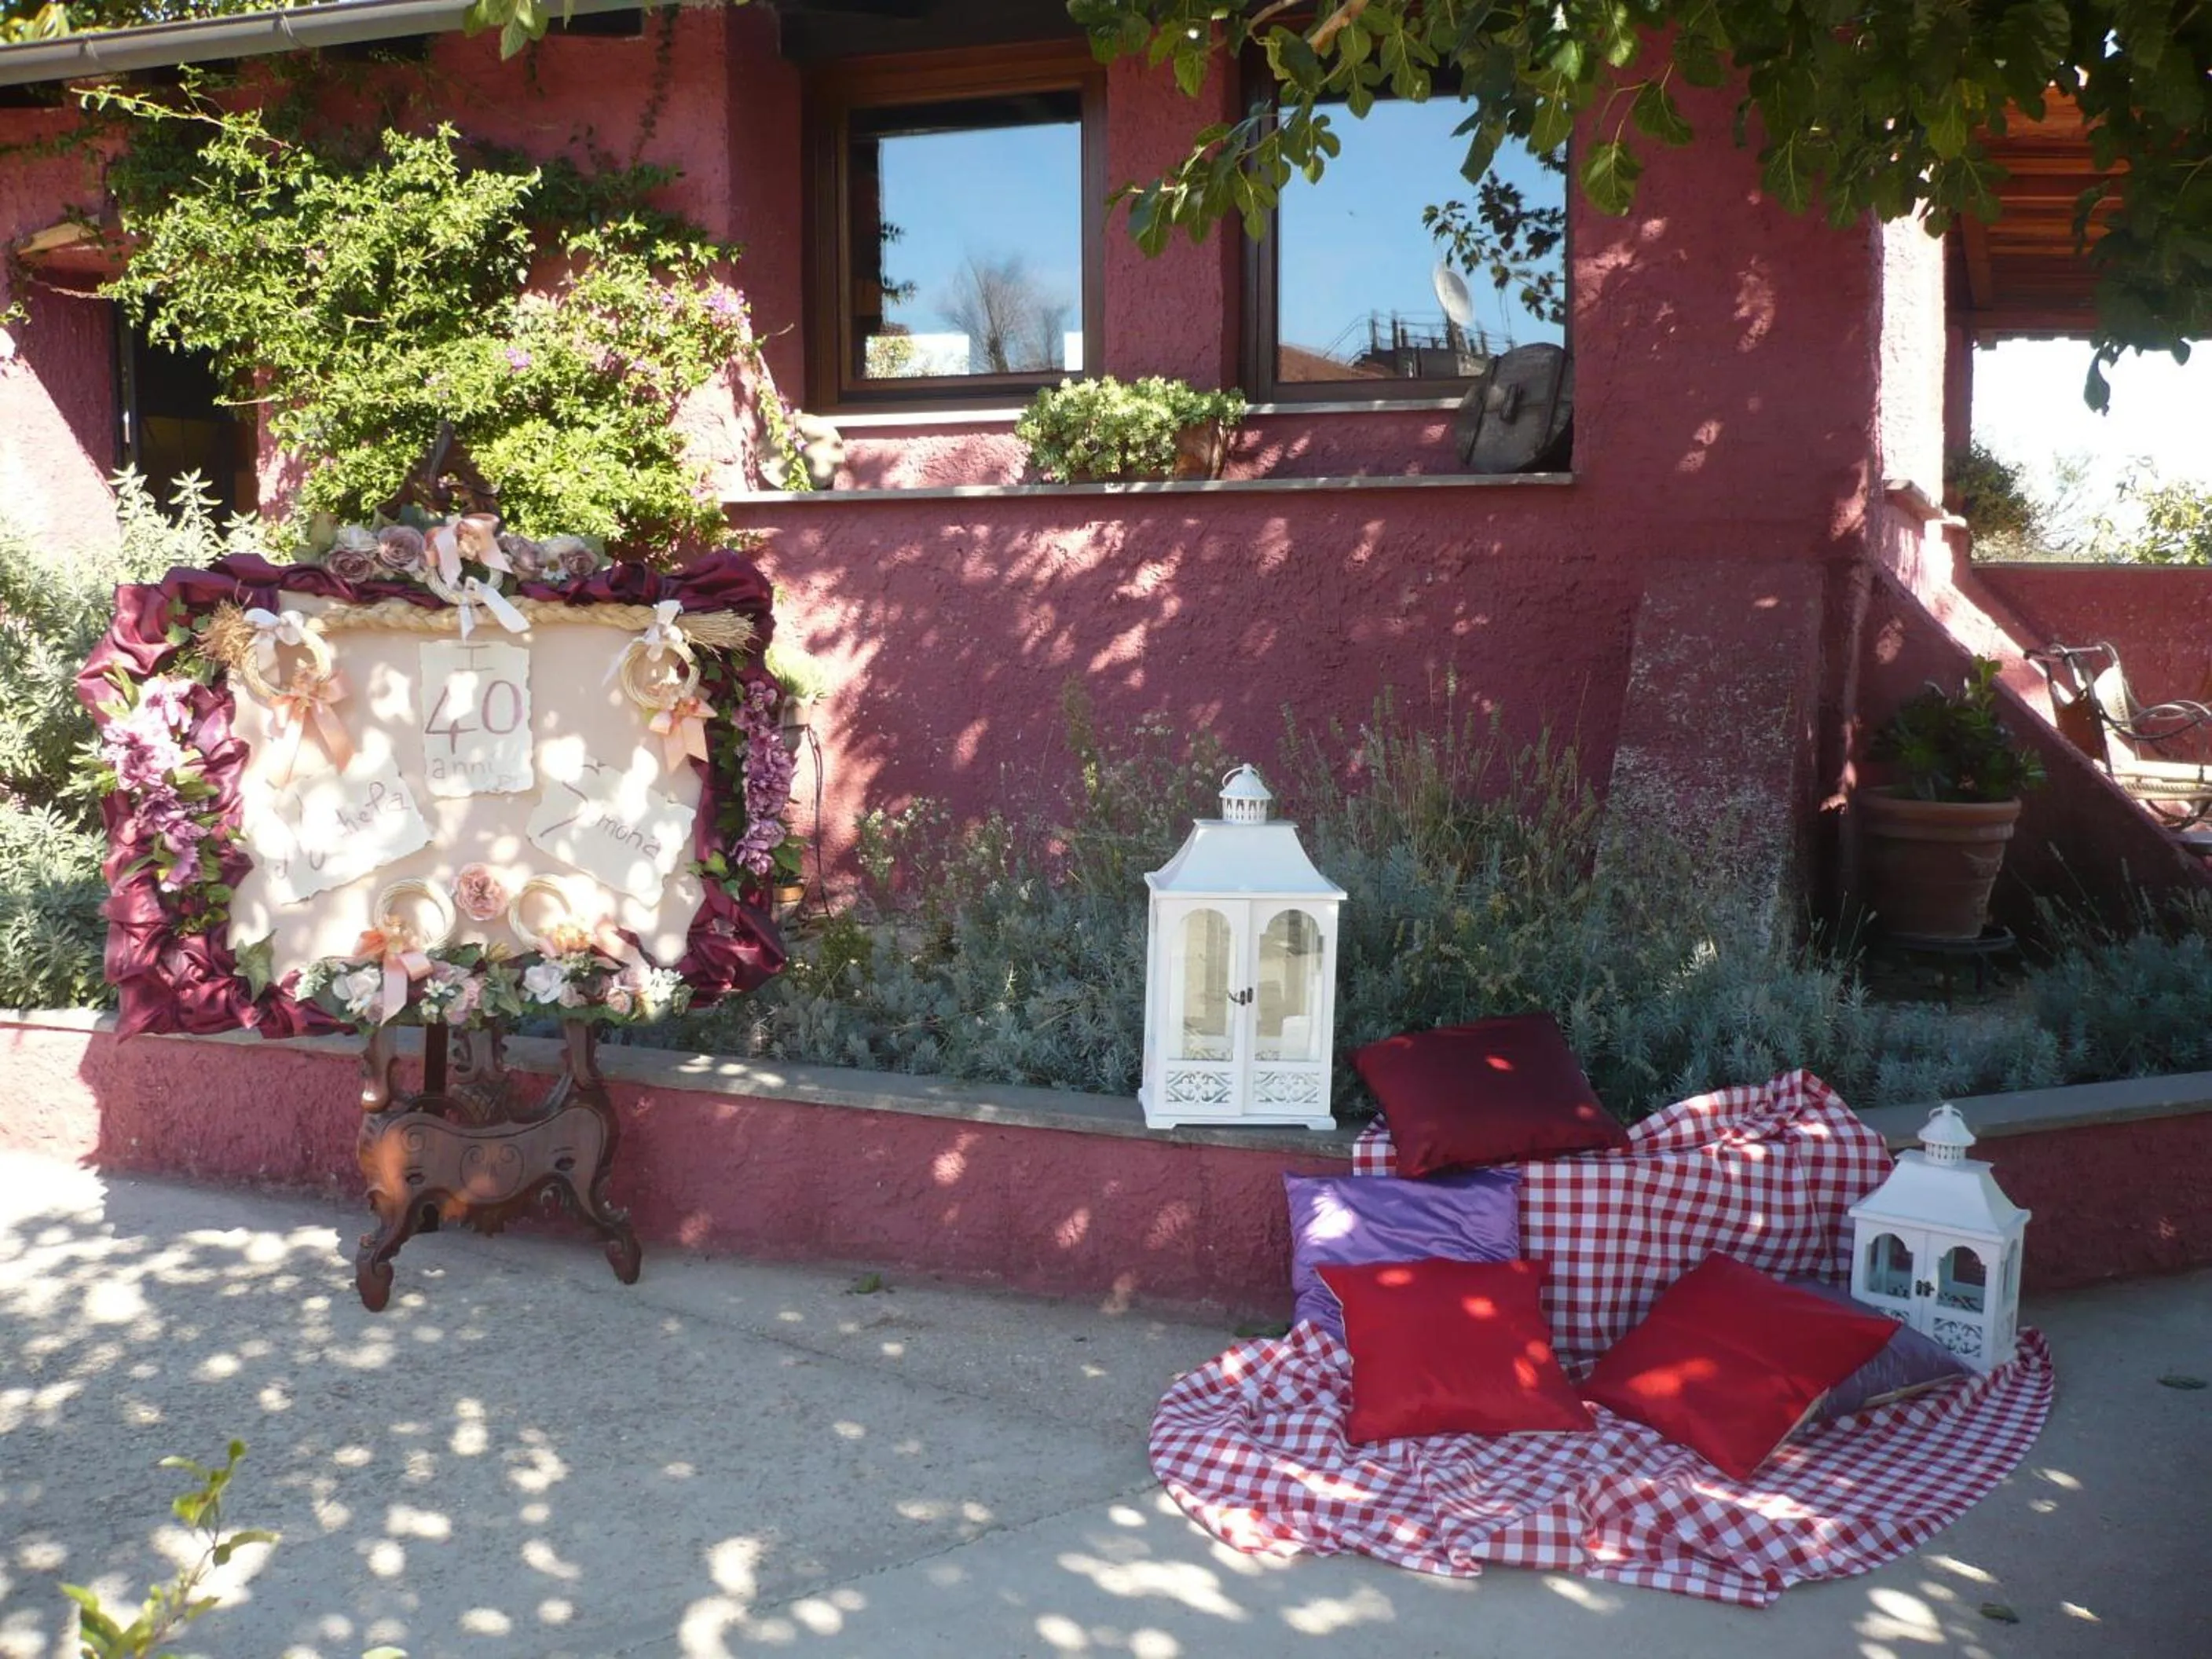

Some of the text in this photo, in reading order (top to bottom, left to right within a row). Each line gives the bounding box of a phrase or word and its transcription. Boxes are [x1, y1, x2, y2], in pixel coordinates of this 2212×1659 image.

[424, 679, 523, 755] 40
[432, 757, 494, 779] anni
[538, 763, 663, 861] Smona
